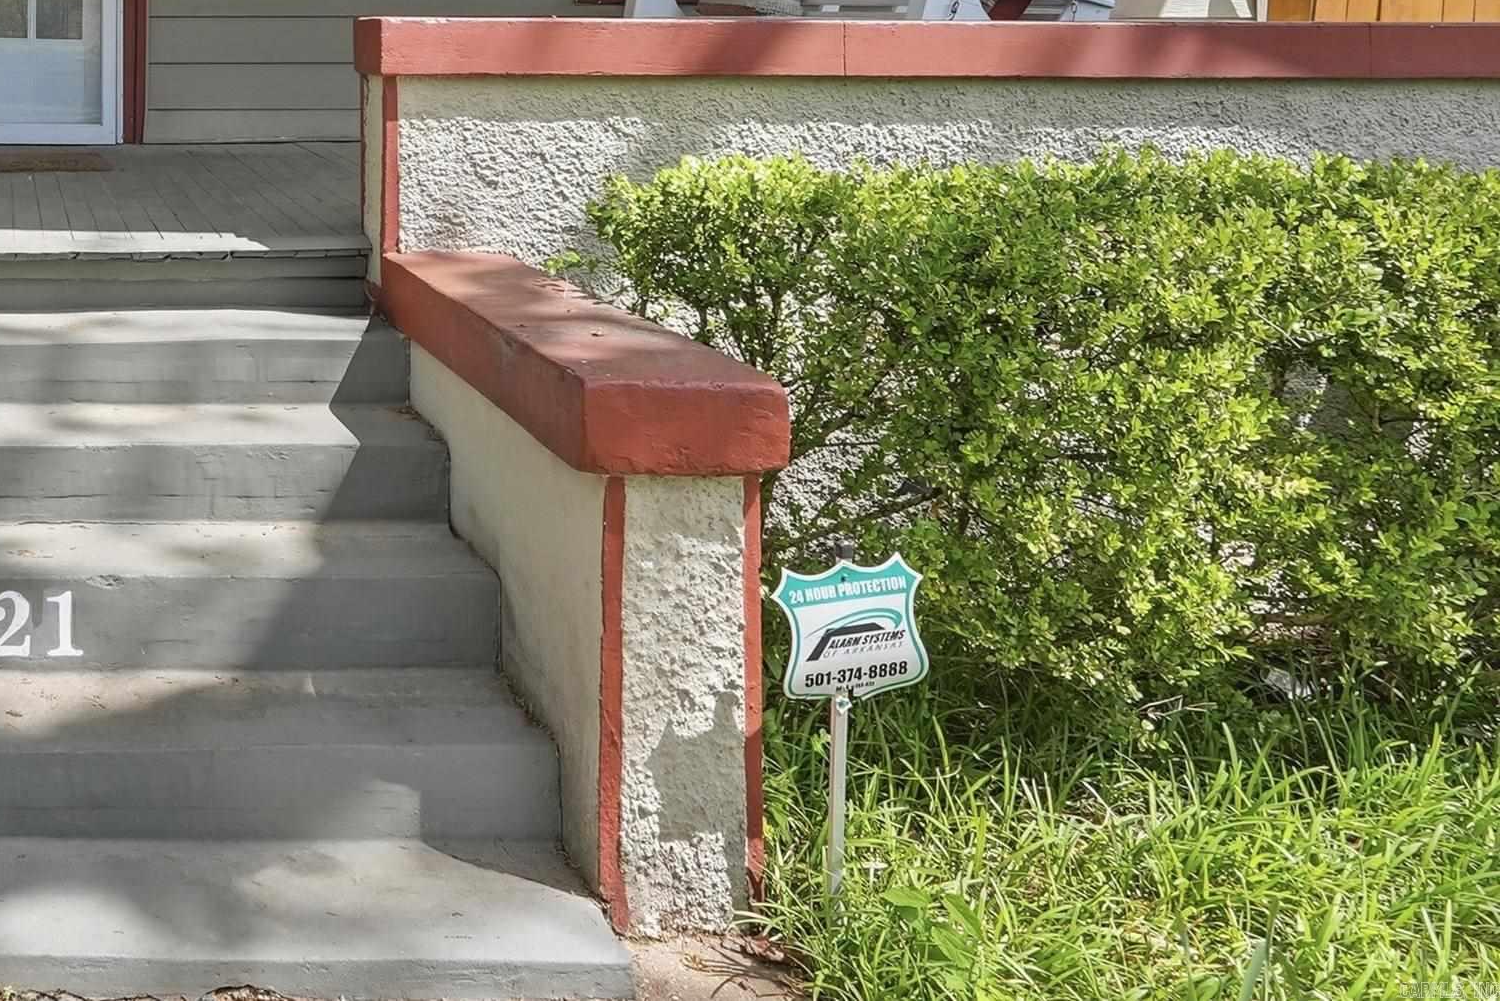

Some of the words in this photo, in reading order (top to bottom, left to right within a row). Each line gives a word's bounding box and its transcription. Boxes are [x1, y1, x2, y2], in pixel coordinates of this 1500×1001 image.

[789, 589, 805, 604] 24
[804, 584, 837, 601] HOUR
[838, 575, 907, 597] PROTECTION
[827, 635, 862, 649] ALARM
[862, 629, 906, 645] SYSTEMS
[805, 661, 908, 687] 501-374-8888
